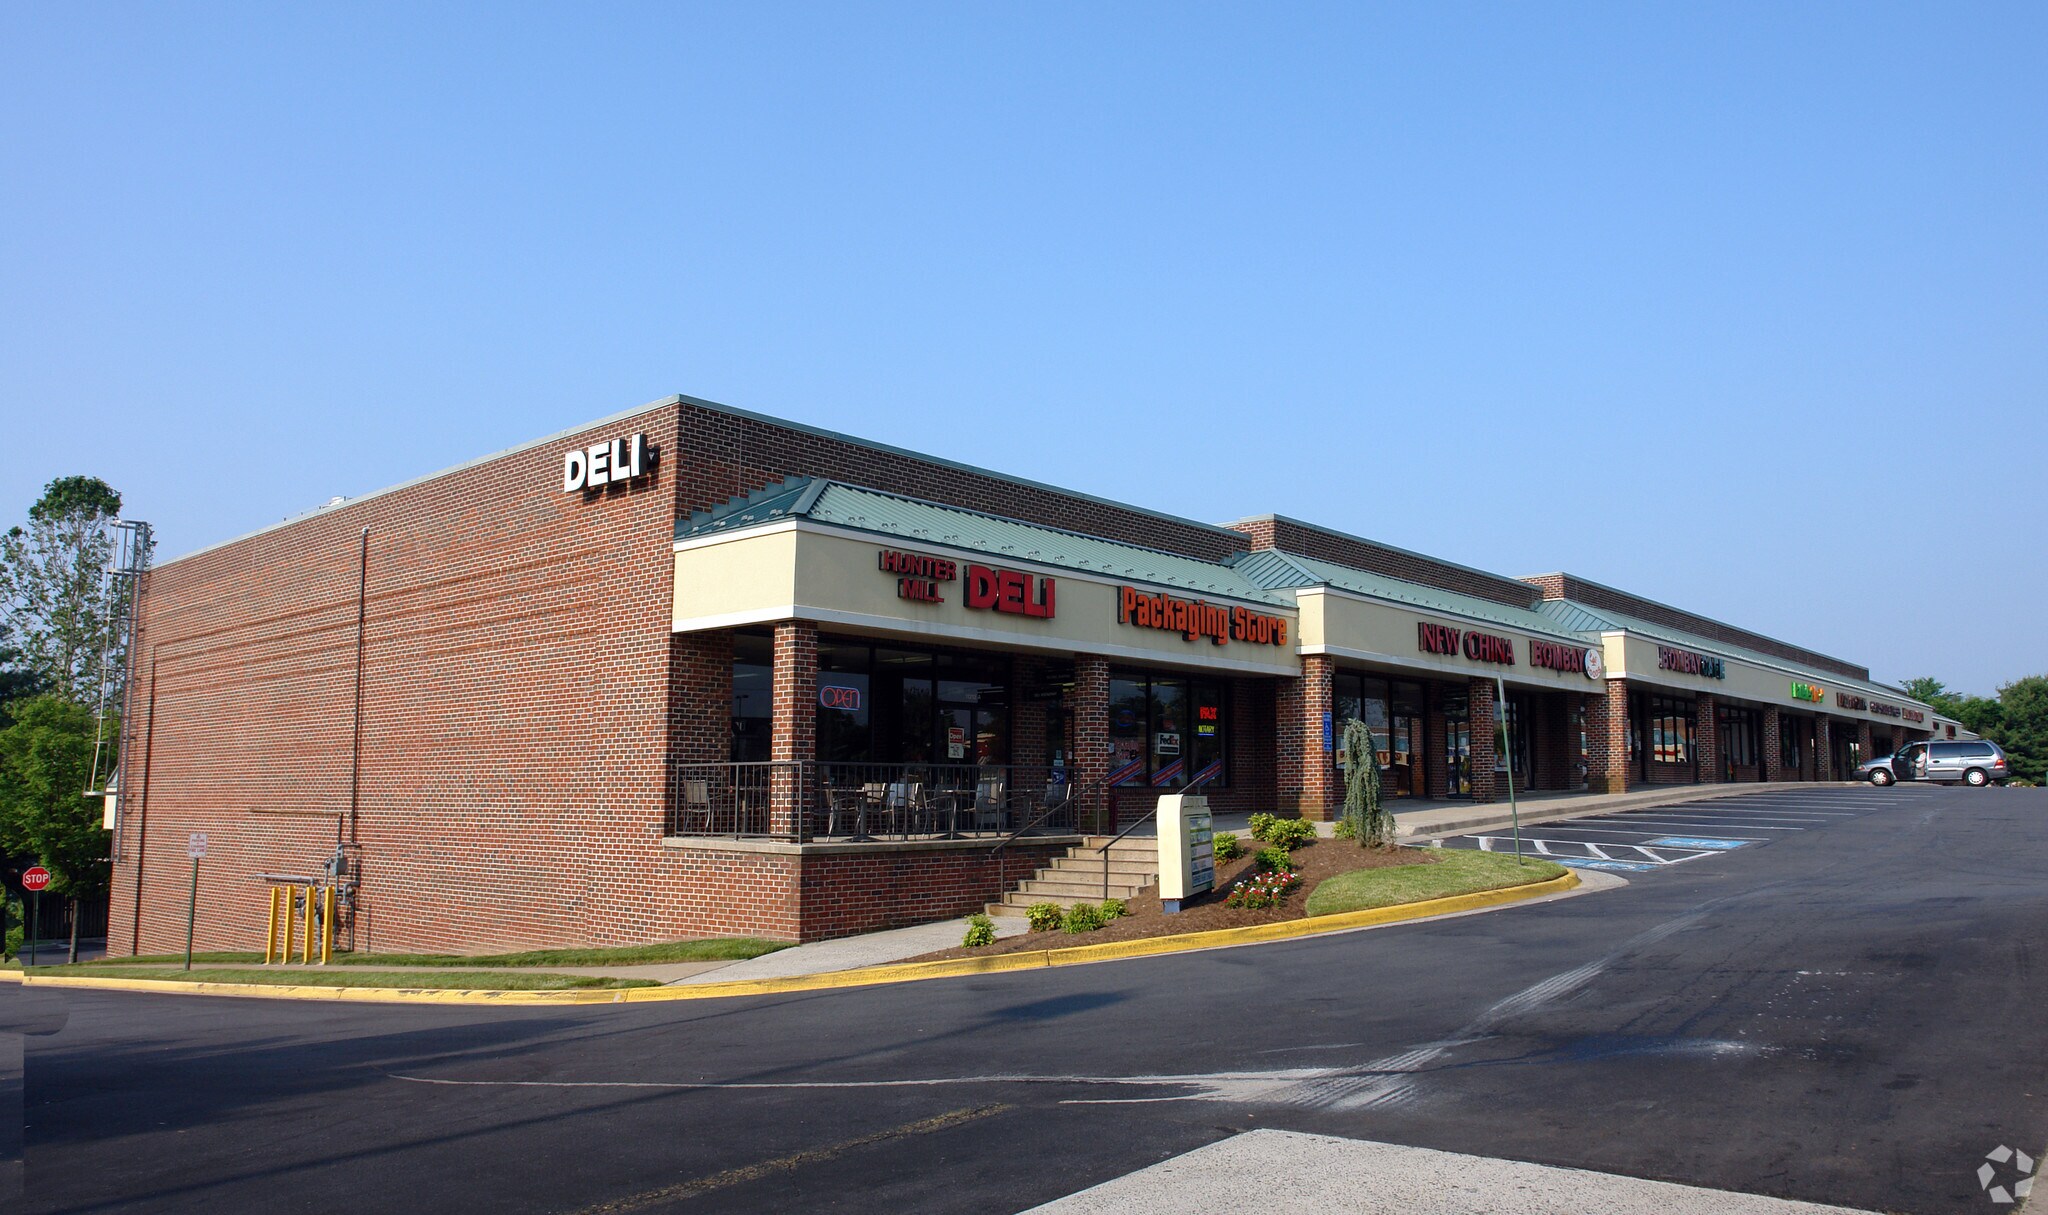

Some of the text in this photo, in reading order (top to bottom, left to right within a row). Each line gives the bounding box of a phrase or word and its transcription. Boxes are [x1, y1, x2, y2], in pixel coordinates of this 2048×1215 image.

[564, 433, 642, 493] DELI
[880, 550, 957, 581] HUNTER
[899, 578, 945, 603] MILL
[965, 565, 1056, 619] DELI
[1119, 586, 1288, 646] Packaging Store
[1419, 622, 1515, 665] NEW CHINA
[1531, 640, 1586, 673] BOMBAY
[1659, 647, 1702, 674] BOMBAY
[821, 687, 860, 709] OPEN
[1159, 735, 1179, 746] FedEx
[25, 873, 49, 885] STOP
